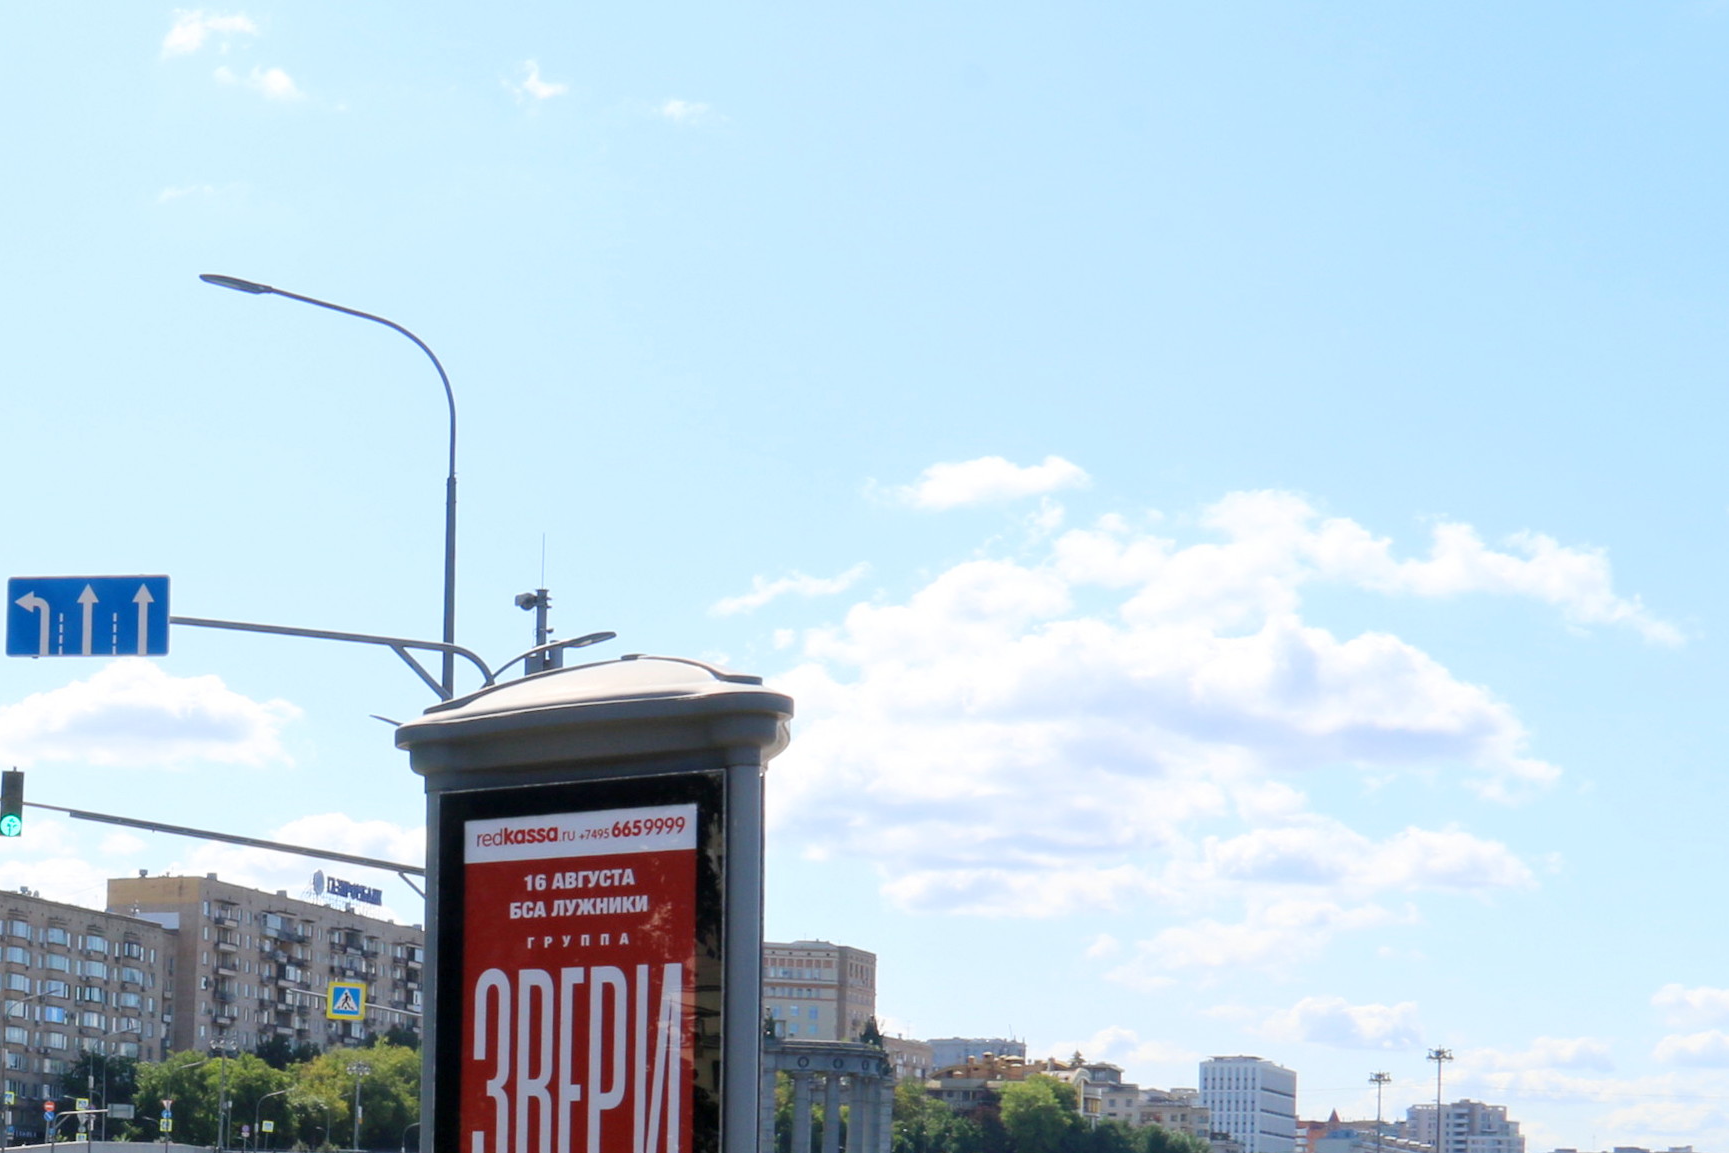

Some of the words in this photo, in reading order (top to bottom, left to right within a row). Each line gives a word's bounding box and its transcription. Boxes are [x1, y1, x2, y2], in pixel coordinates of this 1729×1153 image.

[476, 825, 575, 847] redkassa.ru
[611, 816, 686, 838] 6659999
[524, 875, 546, 891] 16
[552, 868, 635, 890] АВГУСТА
[509, 901, 546, 920] БСА
[551, 894, 649, 917] ЛУЖНИКИ
[526, 932, 631, 950] ГРУППА
